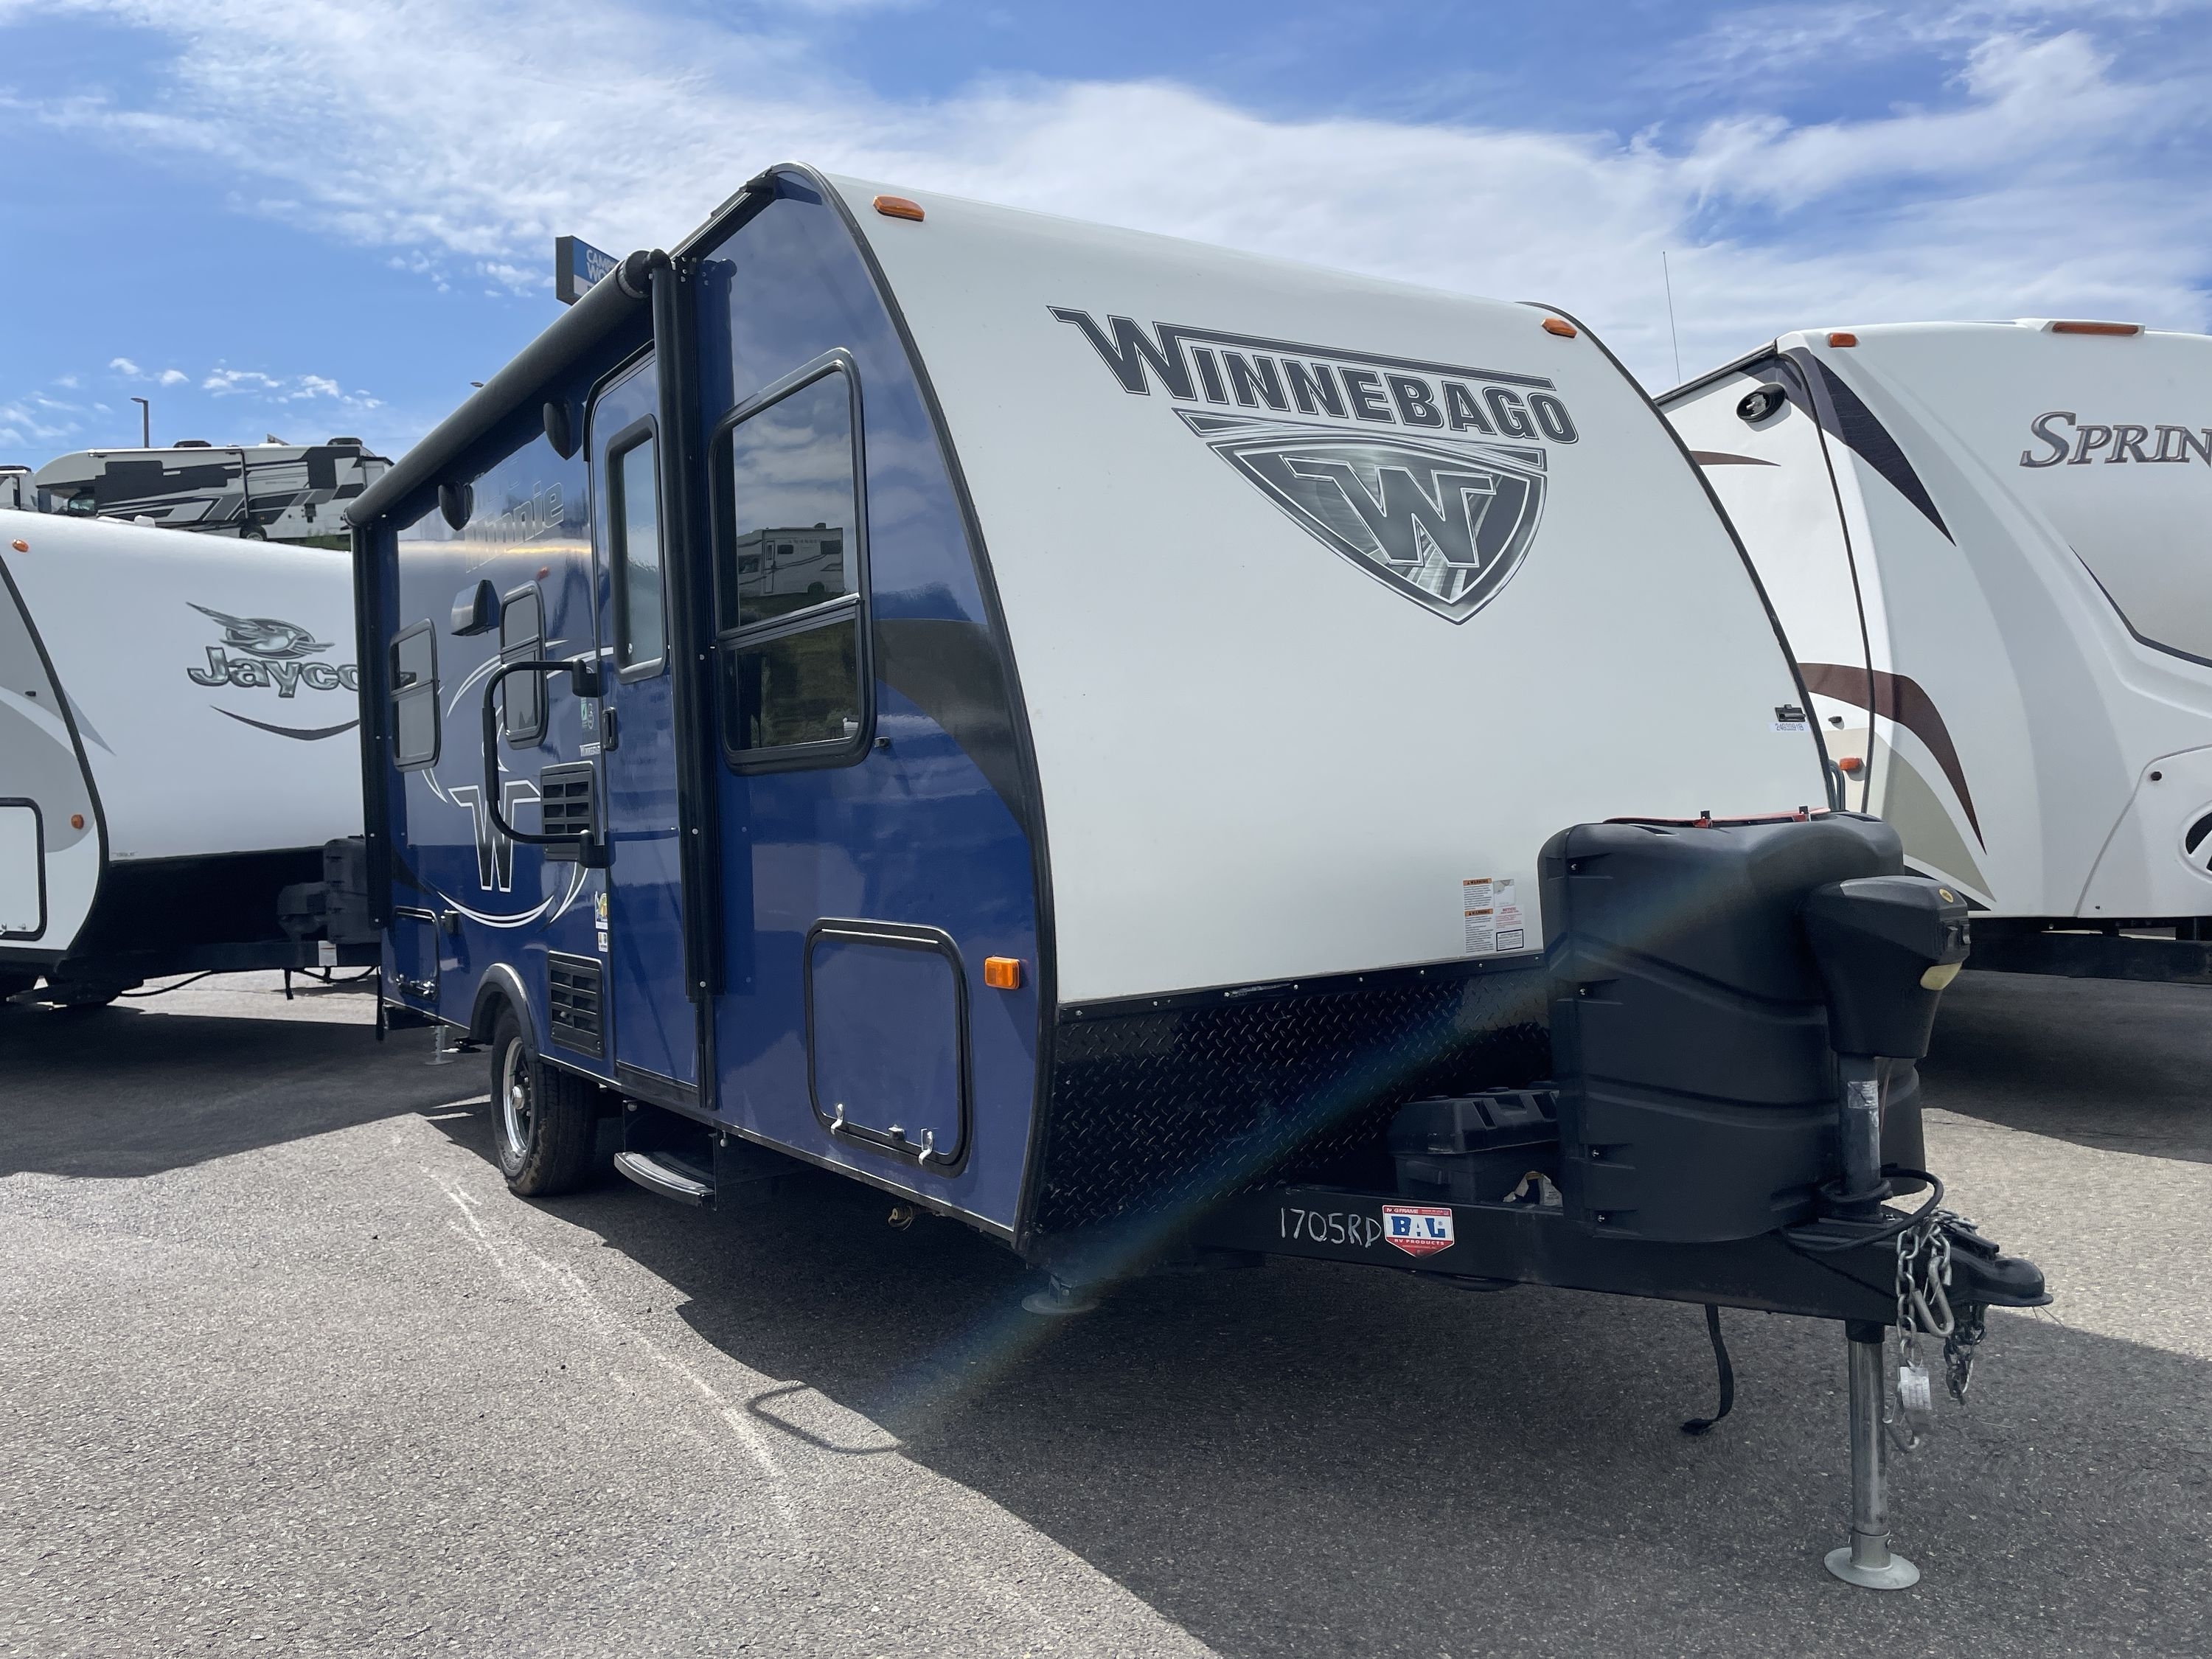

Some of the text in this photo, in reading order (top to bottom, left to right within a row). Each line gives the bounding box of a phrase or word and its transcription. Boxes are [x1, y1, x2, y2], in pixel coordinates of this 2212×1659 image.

[1046, 305, 1580, 445] WINNEBAGO
[2019, 411, 2212, 468] SPRIN
[1281, 1207, 1382, 1248] 1705RD
[1391, 1216, 1445, 1238] BAL
